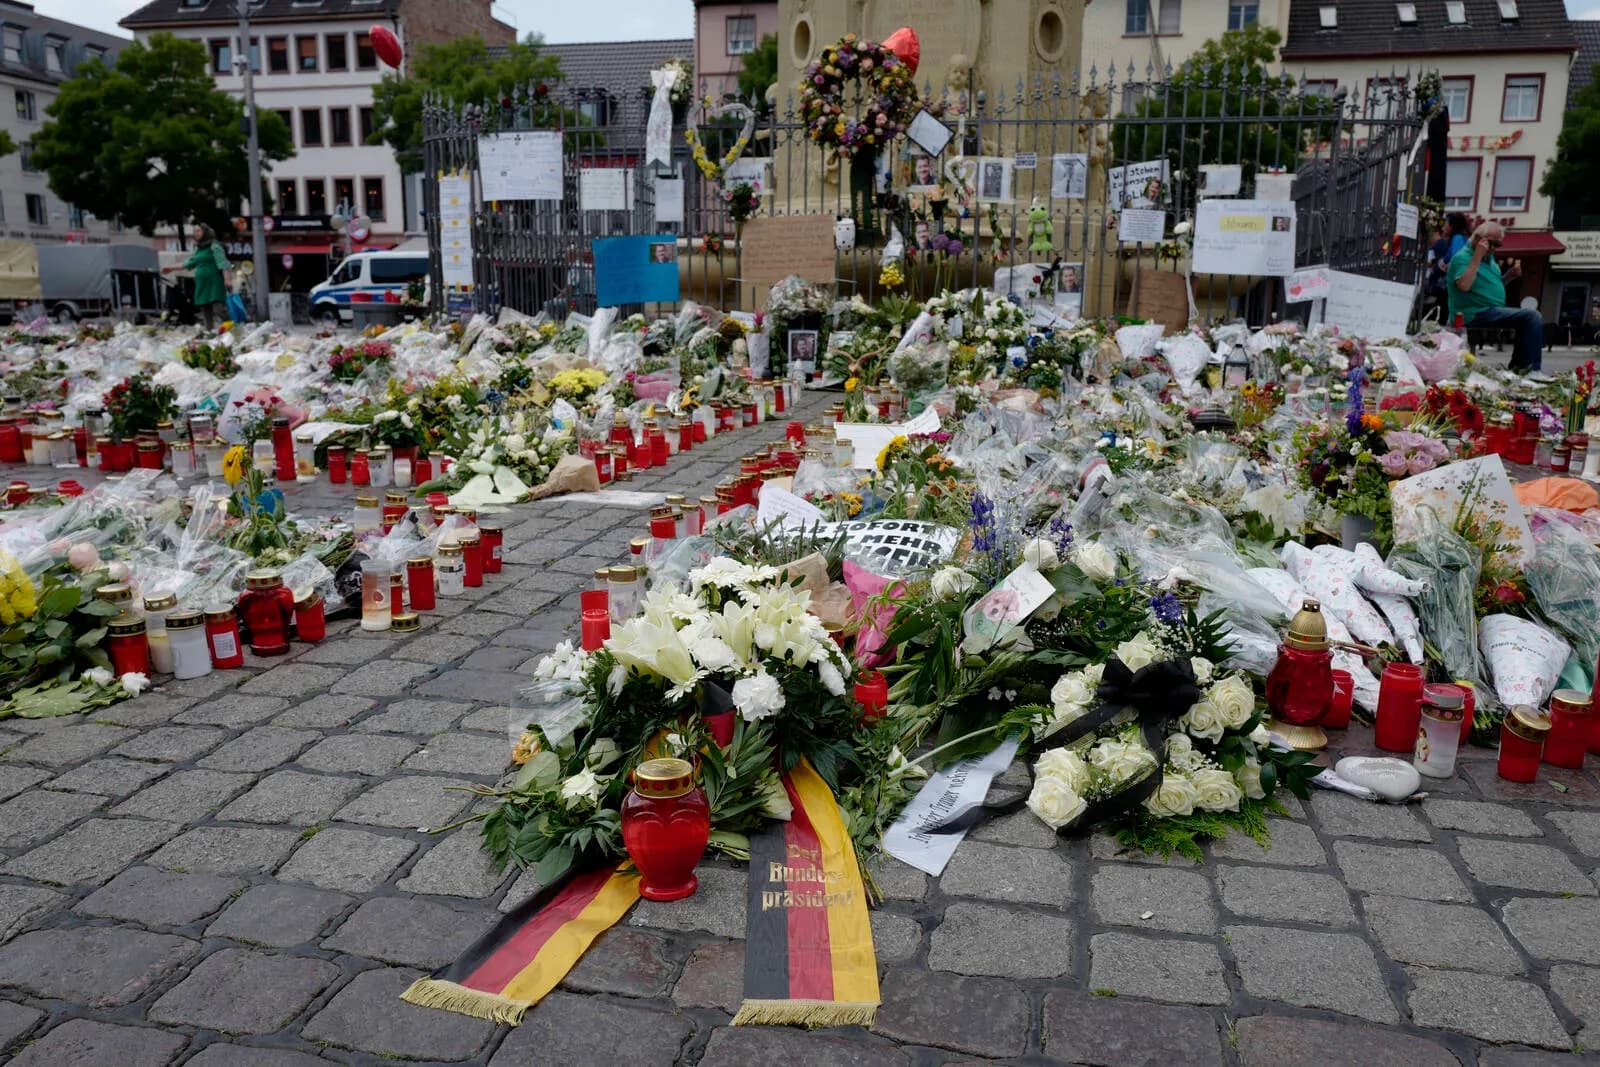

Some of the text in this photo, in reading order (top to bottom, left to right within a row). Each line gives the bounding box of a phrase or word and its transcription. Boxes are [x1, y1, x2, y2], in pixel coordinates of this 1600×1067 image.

[834, 521, 935, 534] SOFORT
[859, 534, 942, 555] MEHR
[786, 844, 818, 863] Der
[761, 890, 854, 913] präsident
